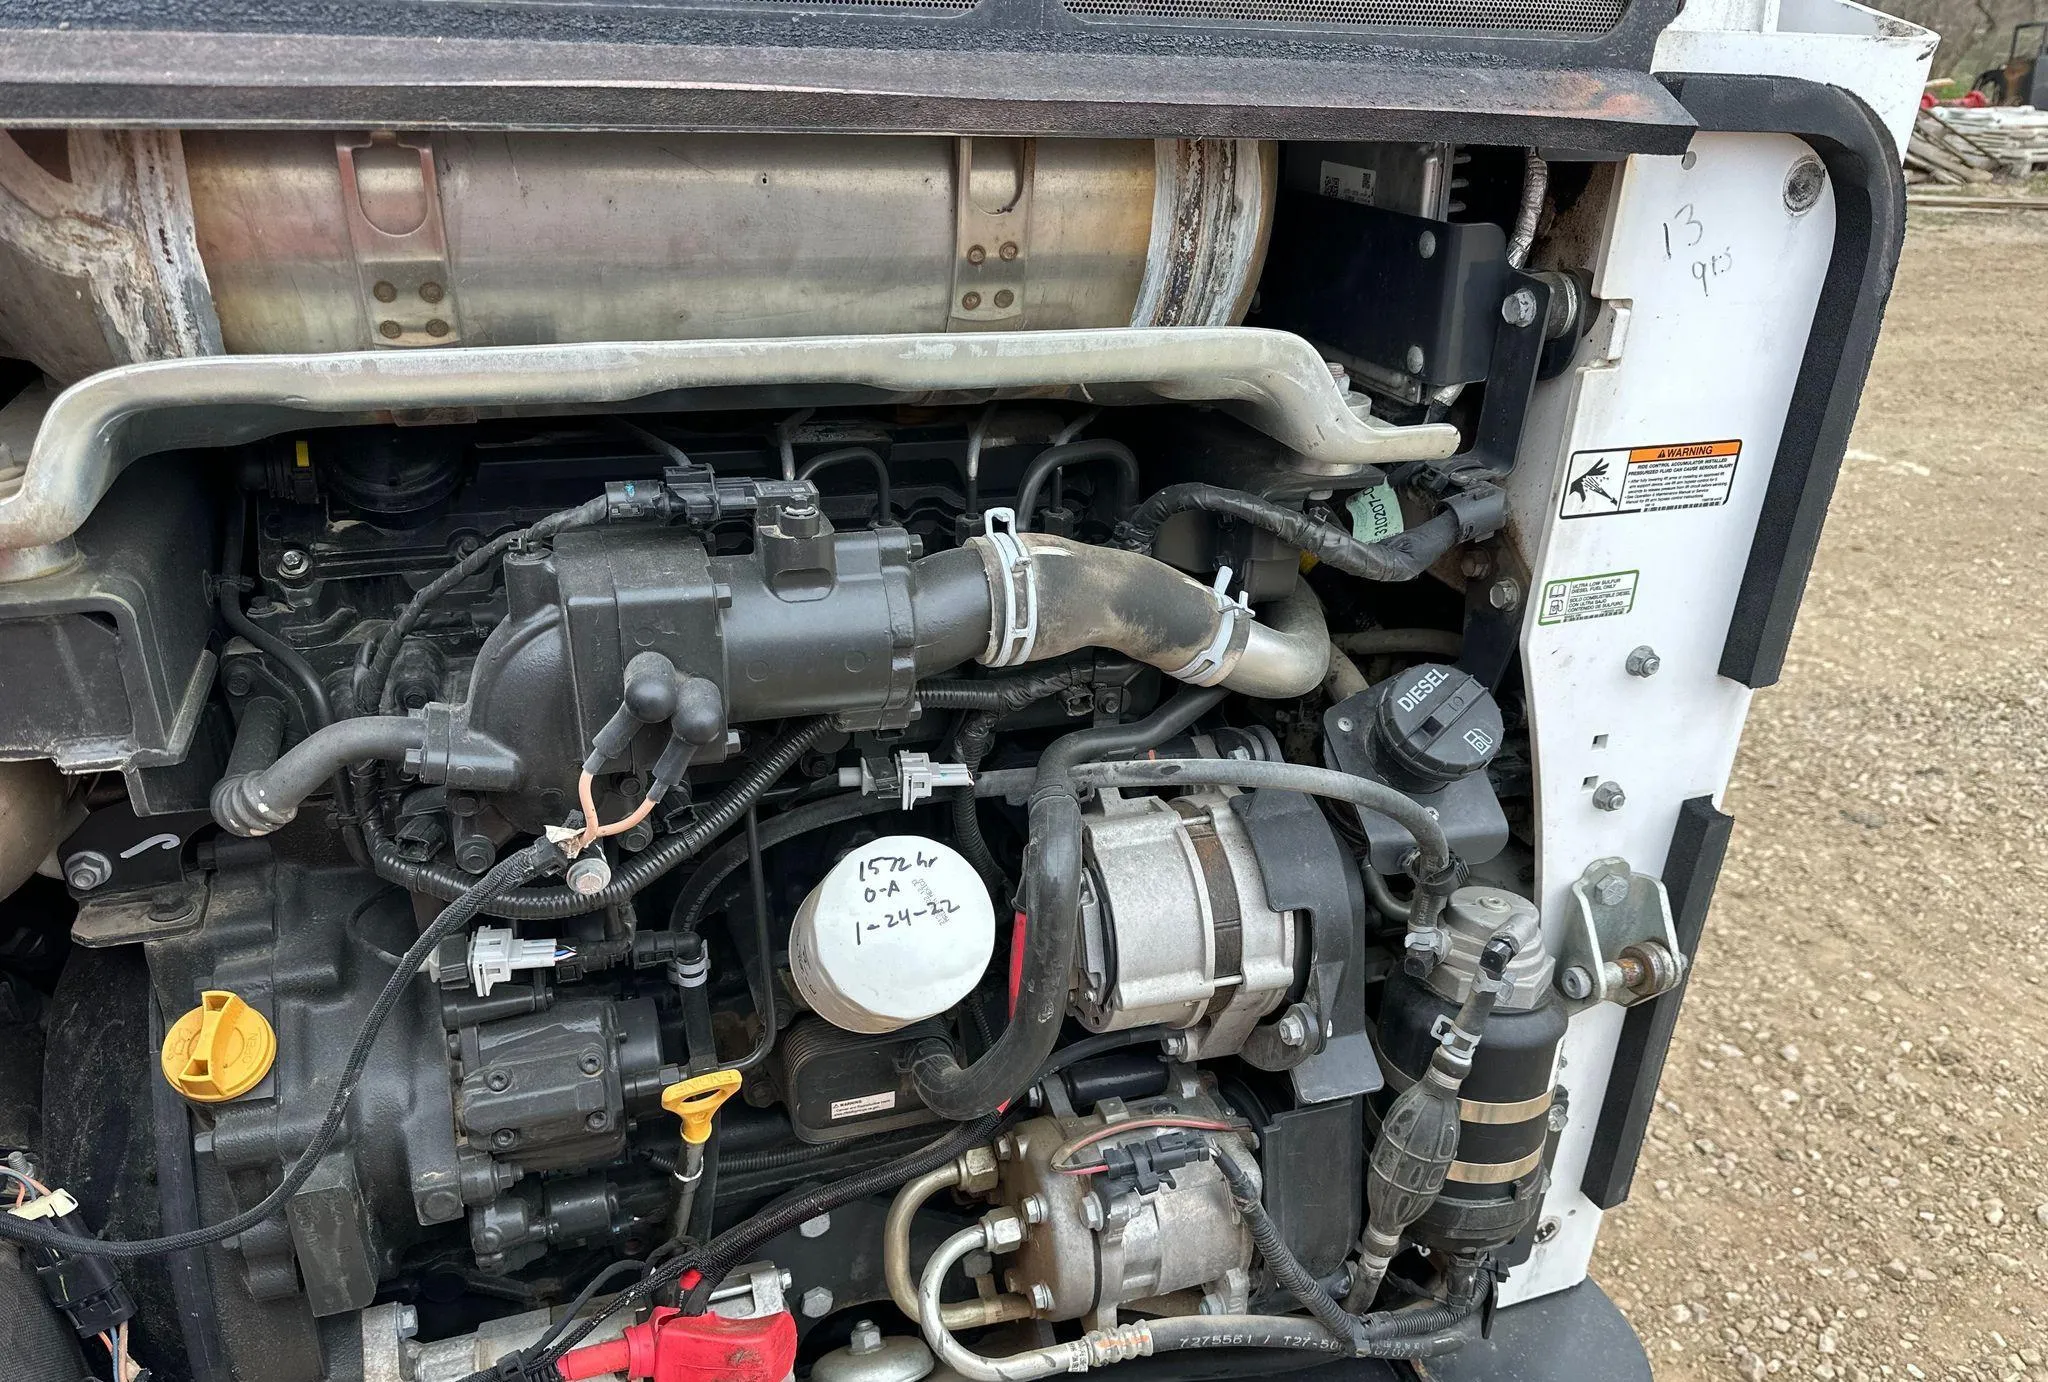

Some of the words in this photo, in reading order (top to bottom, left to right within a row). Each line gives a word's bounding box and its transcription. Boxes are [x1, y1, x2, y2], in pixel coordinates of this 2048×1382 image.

[1663, 203, 1703, 259] 13
[1666, 446, 1714, 458] WARNING
[1397, 668, 1449, 712] DIESEL
[859, 857, 912, 882] 1572
[916, 851, 938, 868] hr
[856, 899, 960, 945] 1-24-22
